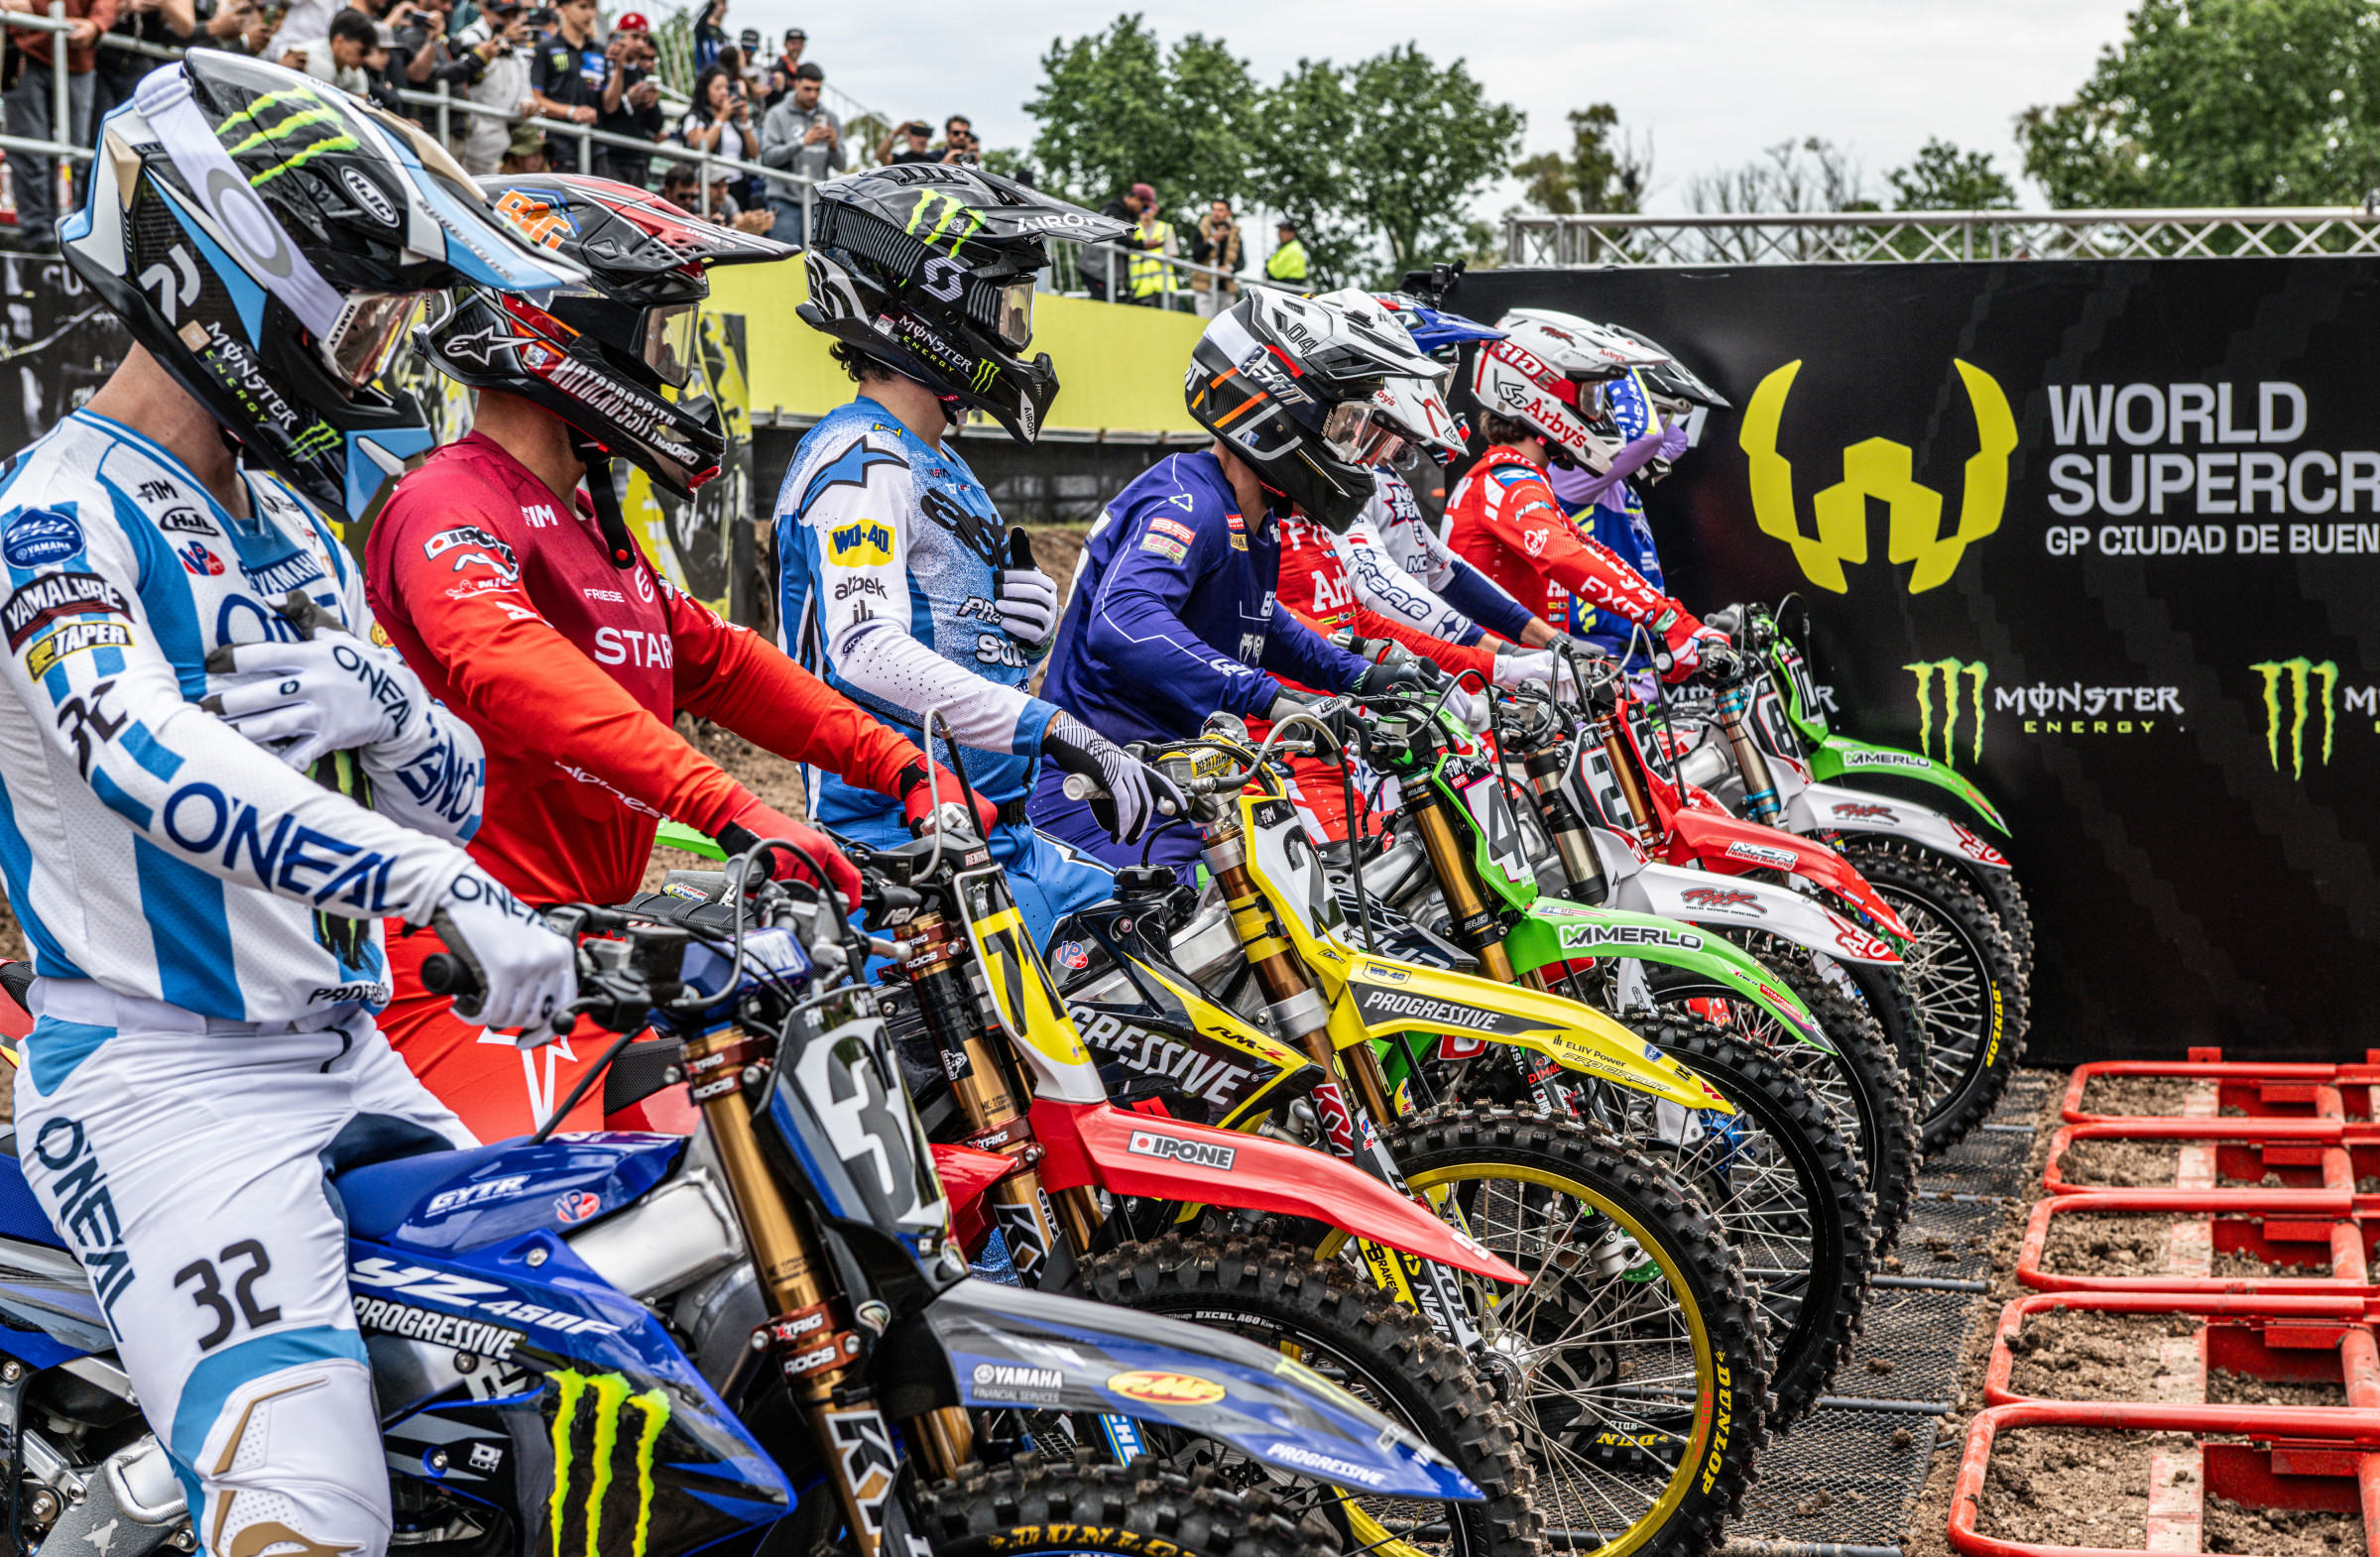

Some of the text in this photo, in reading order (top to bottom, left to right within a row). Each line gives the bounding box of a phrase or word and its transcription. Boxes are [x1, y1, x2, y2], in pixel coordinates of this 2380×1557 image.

[347, 174, 396, 223] HJC
[897, 314, 974, 374] MONSTER
[902, 334, 956, 374] ENERGY
[1599, 348, 1626, 362] Arby's
[205, 320, 298, 430] MONSTER
[205, 350, 269, 421] ENERGY
[1022, 406, 1036, 436] AIROH
[1523, 397, 1587, 448] Arby's
[2047, 382, 2309, 446] WORLD
[138, 479, 179, 503] FIM
[832, 524, 892, 556] WD-40
[2045, 526, 2090, 556] GP
[2098, 524, 2227, 555] CIUDAD
[2236, 524, 2281, 554] DE
[583, 588, 626, 603] FRIESE
[55, 623, 127, 658] TAPER
[1994, 682, 2186, 716] MONSTER
[2024, 720, 2156, 735] ENERGY
[1445, 757, 1465, 778] FIM
[1864, 752, 1931, 769] MERLO
[1260, 806, 1275, 824] FIM
[1488, 781, 1526, 871] 4
[1726, 849, 1794, 871] Honda Racing
[1729, 842, 1798, 864] MCR
[1546, 906, 1575, 916] HILL
[1593, 926, 1706, 951] MERLO
[905, 950, 938, 970] ROCS
[1364, 991, 1501, 1031] PROGRESSIVE
[1985, 989, 2003, 1068] DUNLOP
[1593, 1049, 1626, 1068] Power
[692, 1076, 735, 1099] ROCS
[968, 1131, 1009, 1151] XTRIG
[1151, 1138, 1235, 1170] IPONE
[425, 1174, 532, 1215] GYTR
[174, 1238, 283, 1352] 32
[352, 1295, 523, 1363] PROGRESSIVE
[477, 1299, 623, 1336] 450F
[772, 1312, 824, 1340] XTRIG
[1195, 1310, 1274, 1330] EXCEL A60 Rim
[783, 1346, 837, 1376] ROCS
[995, 1365, 1064, 1389] YAMAHA
[973, 1387, 1061, 1404] FINANCIAL SERVICES
[1702, 1362, 1732, 1497] DUNLOP
[1265, 1442, 1386, 1487] PROGRESSIVE
